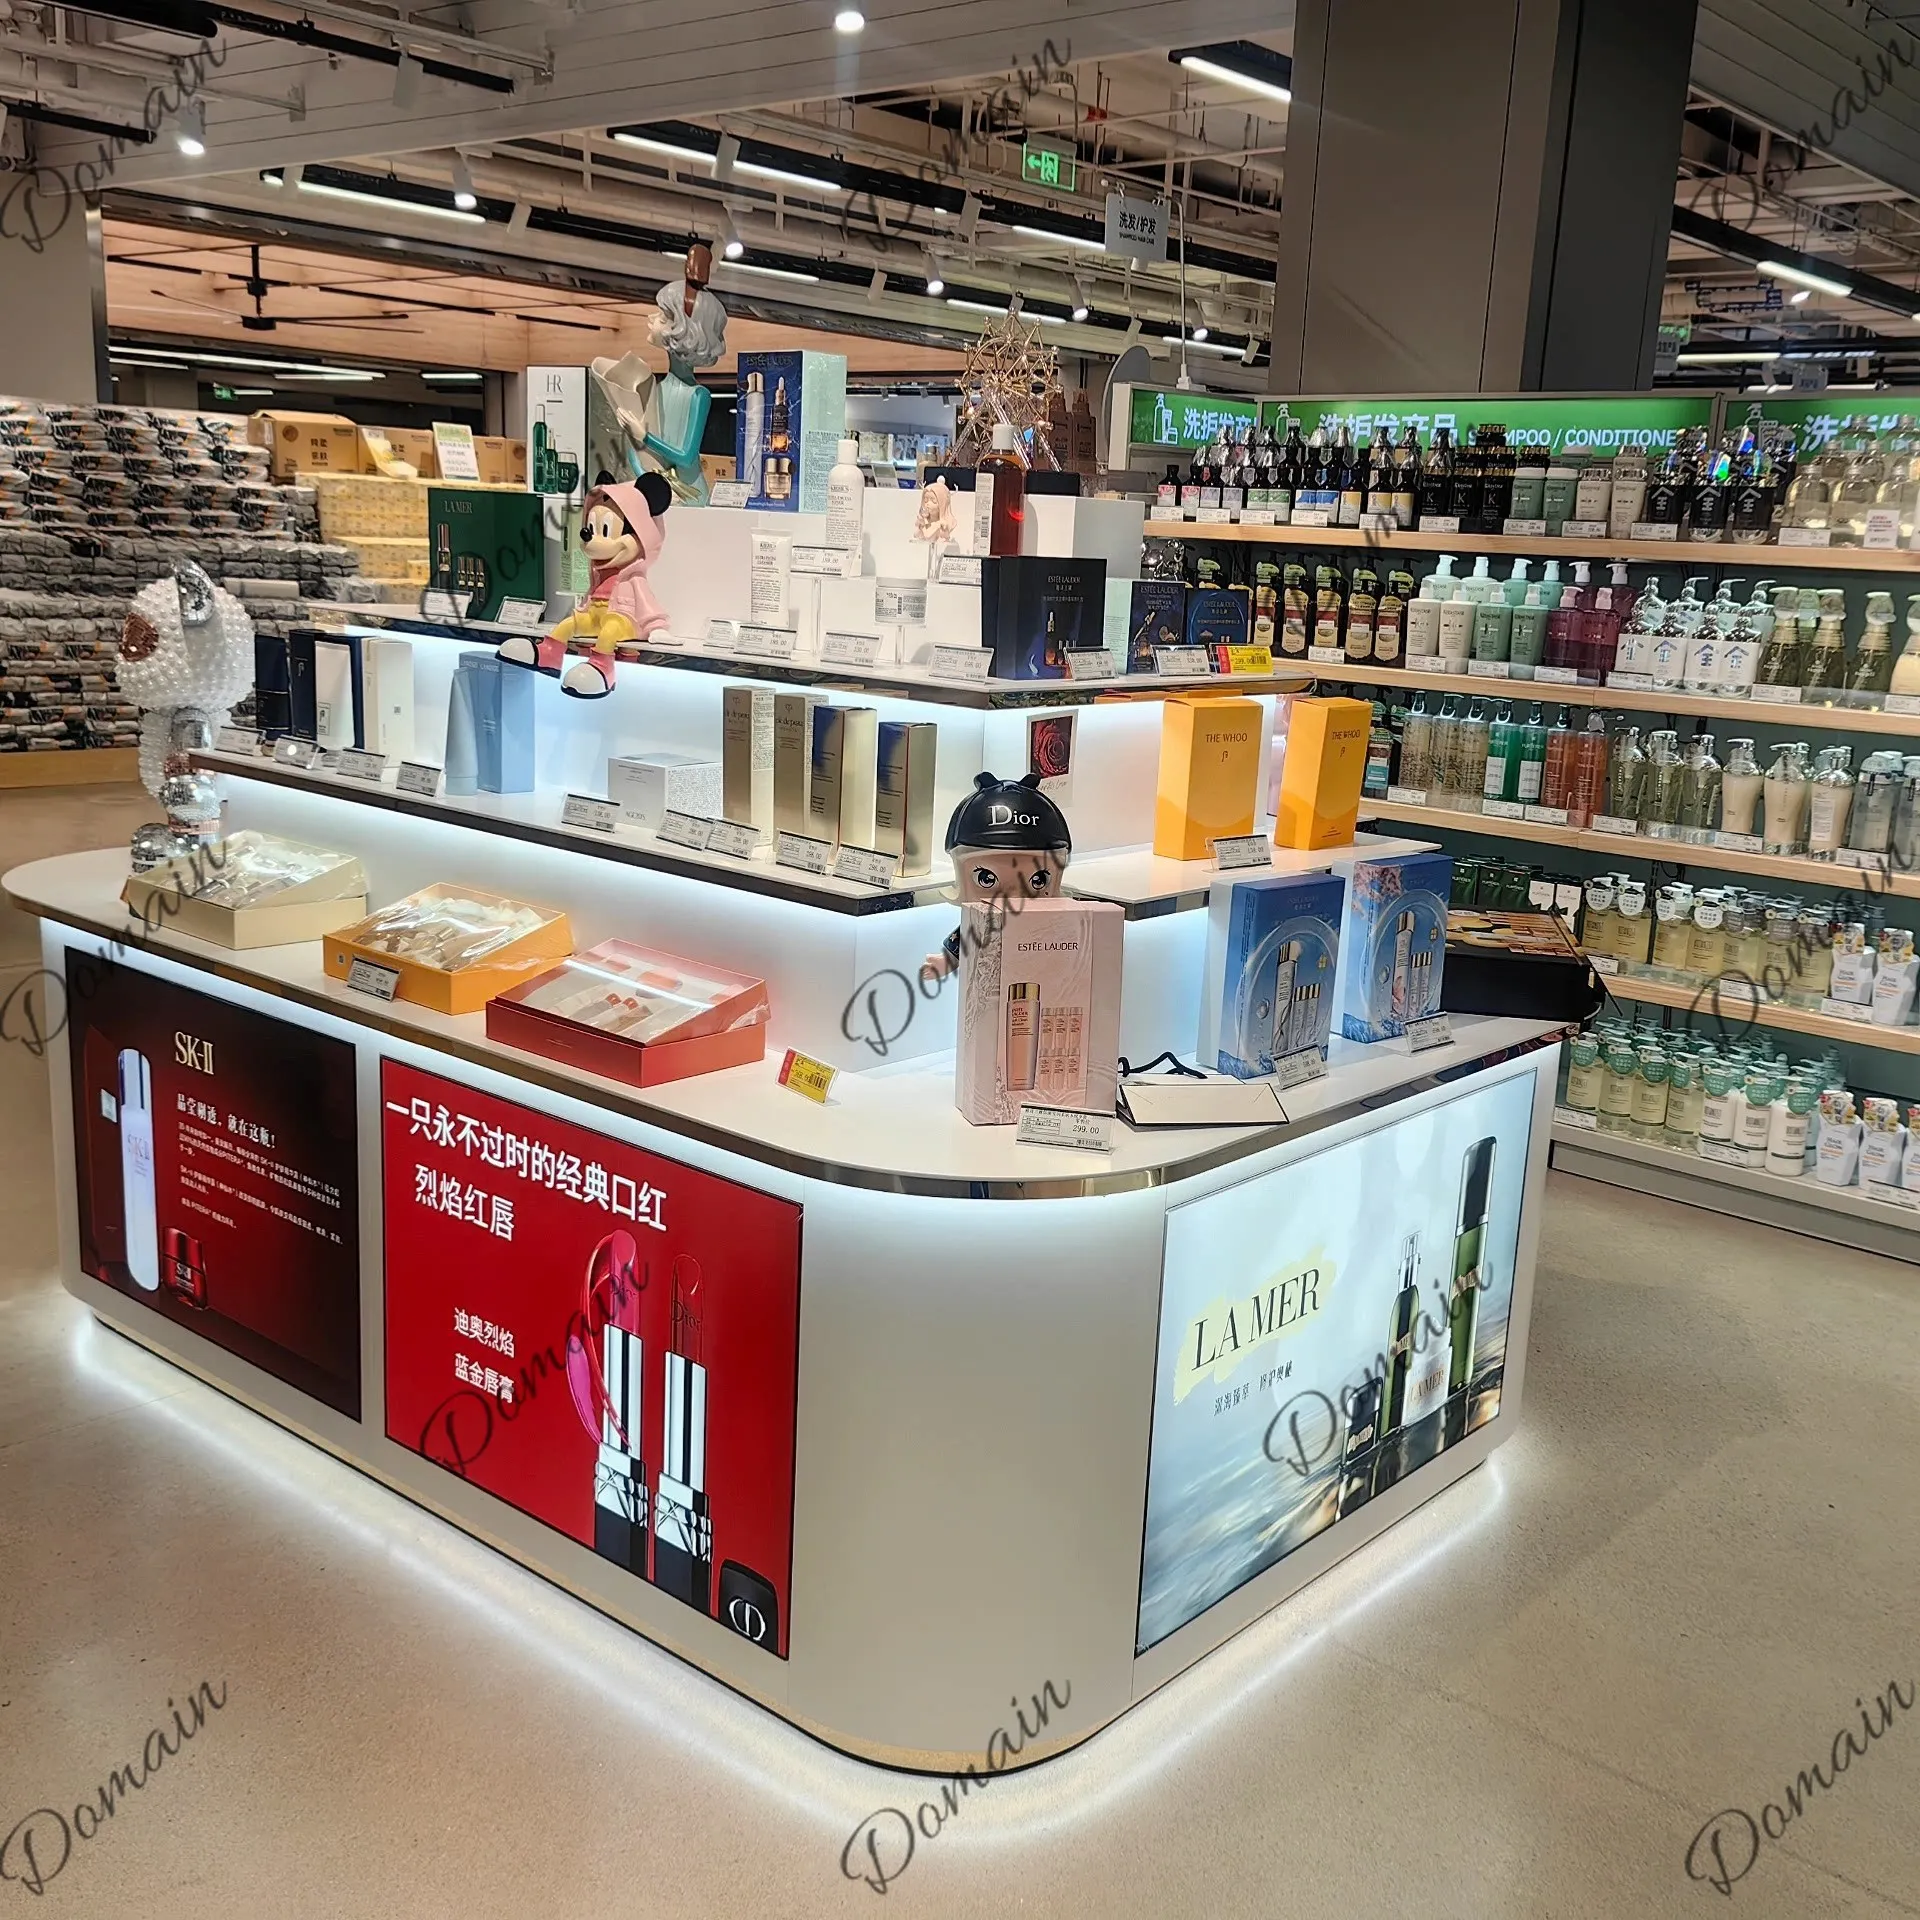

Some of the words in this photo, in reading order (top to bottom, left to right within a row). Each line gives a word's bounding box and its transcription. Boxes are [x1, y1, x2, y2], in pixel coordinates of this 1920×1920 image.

[1564, 426, 1677, 448] CONDITIONE
[1206, 733, 1221, 743] THE
[1222, 732, 1248, 743] WHOO
[1331, 731, 1342, 740] THE
[988, 804, 1040, 826] Dior
[1044, 942, 1078, 951] LAUDER
[175, 1031, 215, 1075] SK-II
[1072, 1124, 1100, 1134] 299.00
[386, 1097, 667, 1232] 一只永不过时的经典口红
[415, 1164, 515, 1241] 烈焰红唇
[453, 1307, 515, 1359] 迪奥烈焰
[1191, 1306, 1241, 1371] LA
[1248, 1268, 1320, 1344] MER
[454, 1353, 515, 1404] 蓝金唇膏
